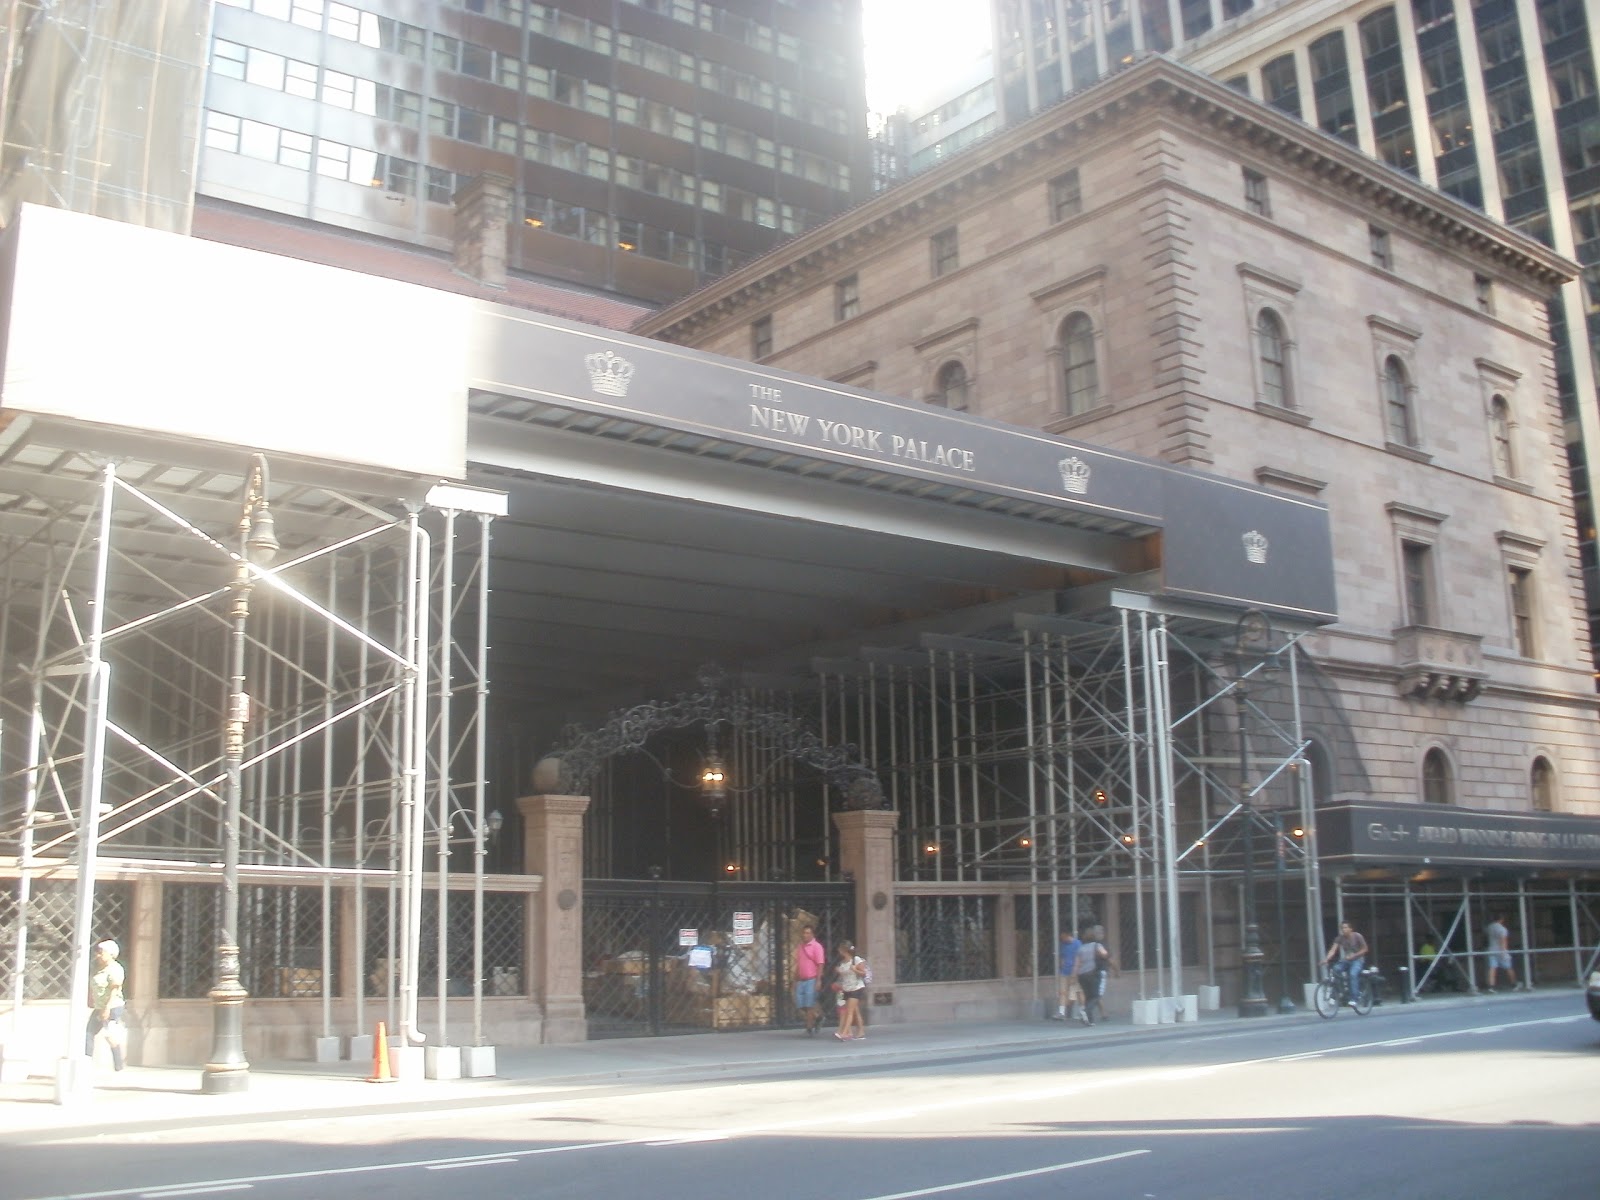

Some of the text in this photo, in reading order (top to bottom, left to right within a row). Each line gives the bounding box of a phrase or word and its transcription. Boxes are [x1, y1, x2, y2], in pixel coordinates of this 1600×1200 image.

[749, 384, 782, 402] THE
[750, 404, 976, 472] NEW YORK PALACE
